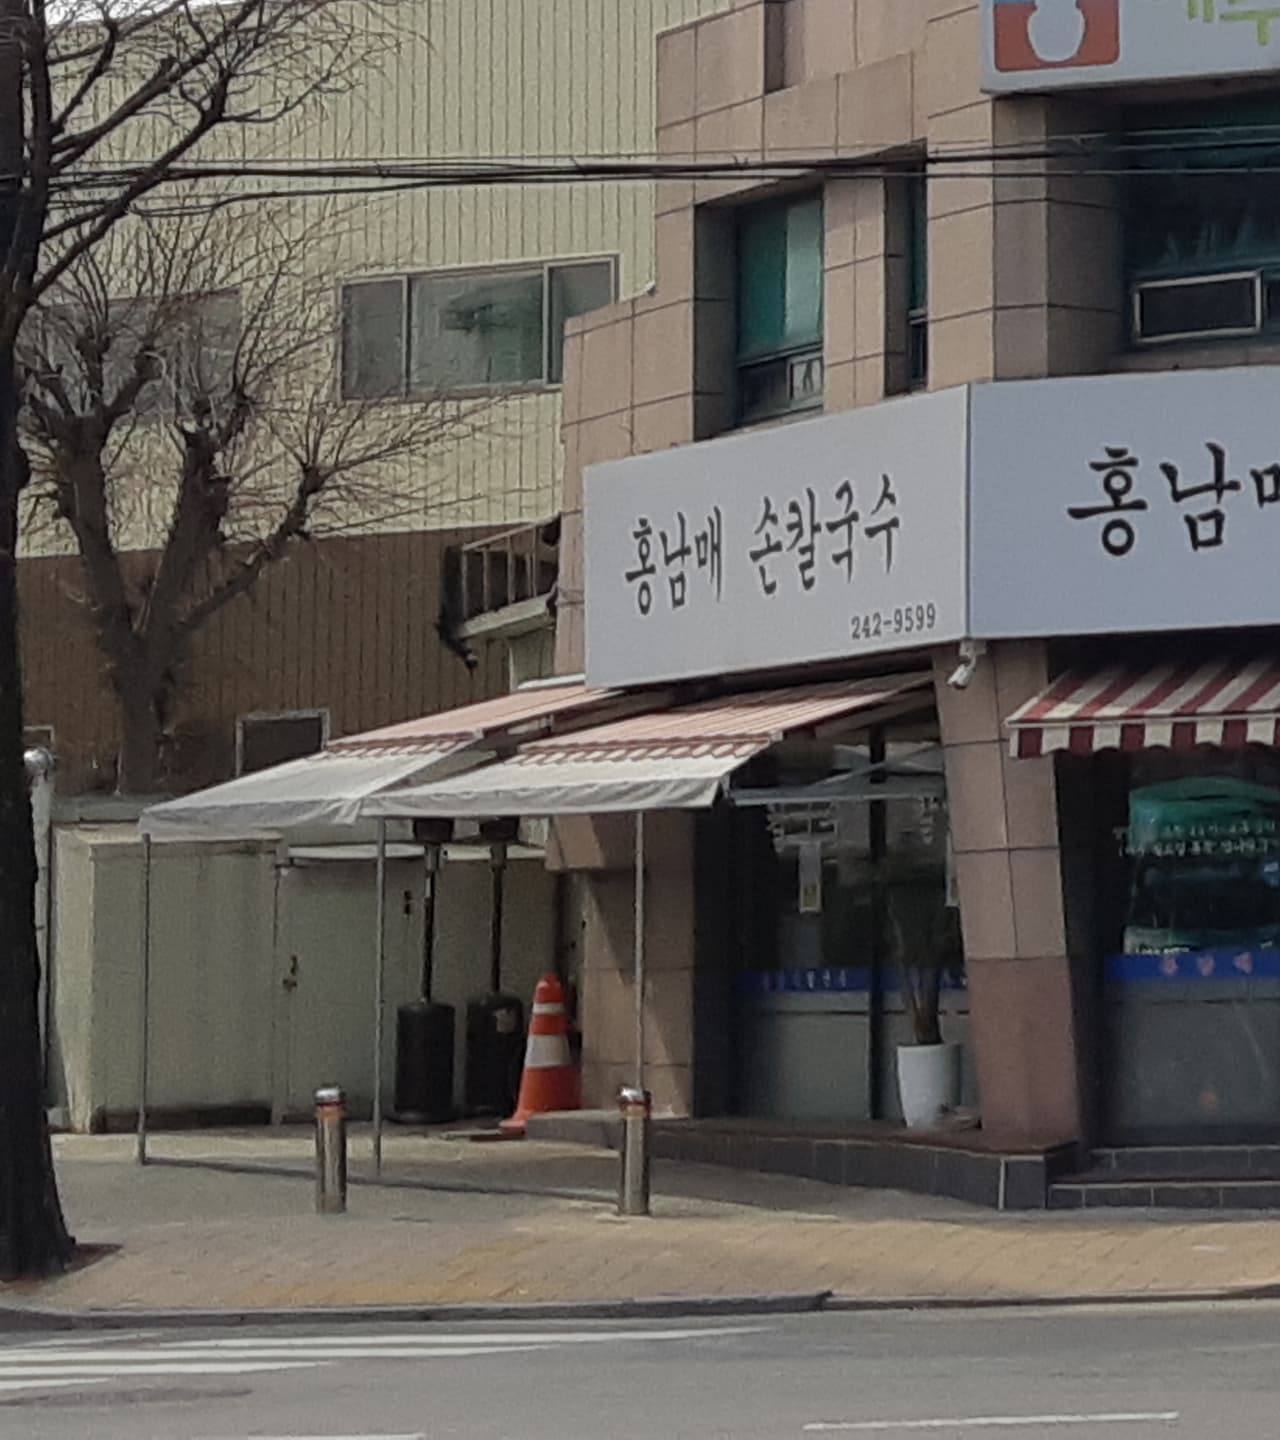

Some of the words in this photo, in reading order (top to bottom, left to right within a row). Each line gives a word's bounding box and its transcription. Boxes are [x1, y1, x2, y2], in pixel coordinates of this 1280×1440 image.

[623, 503, 724, 618] 홍남매
[748, 471, 902, 598] 손칼국수
[850, 604, 938, 640] 242-9599
